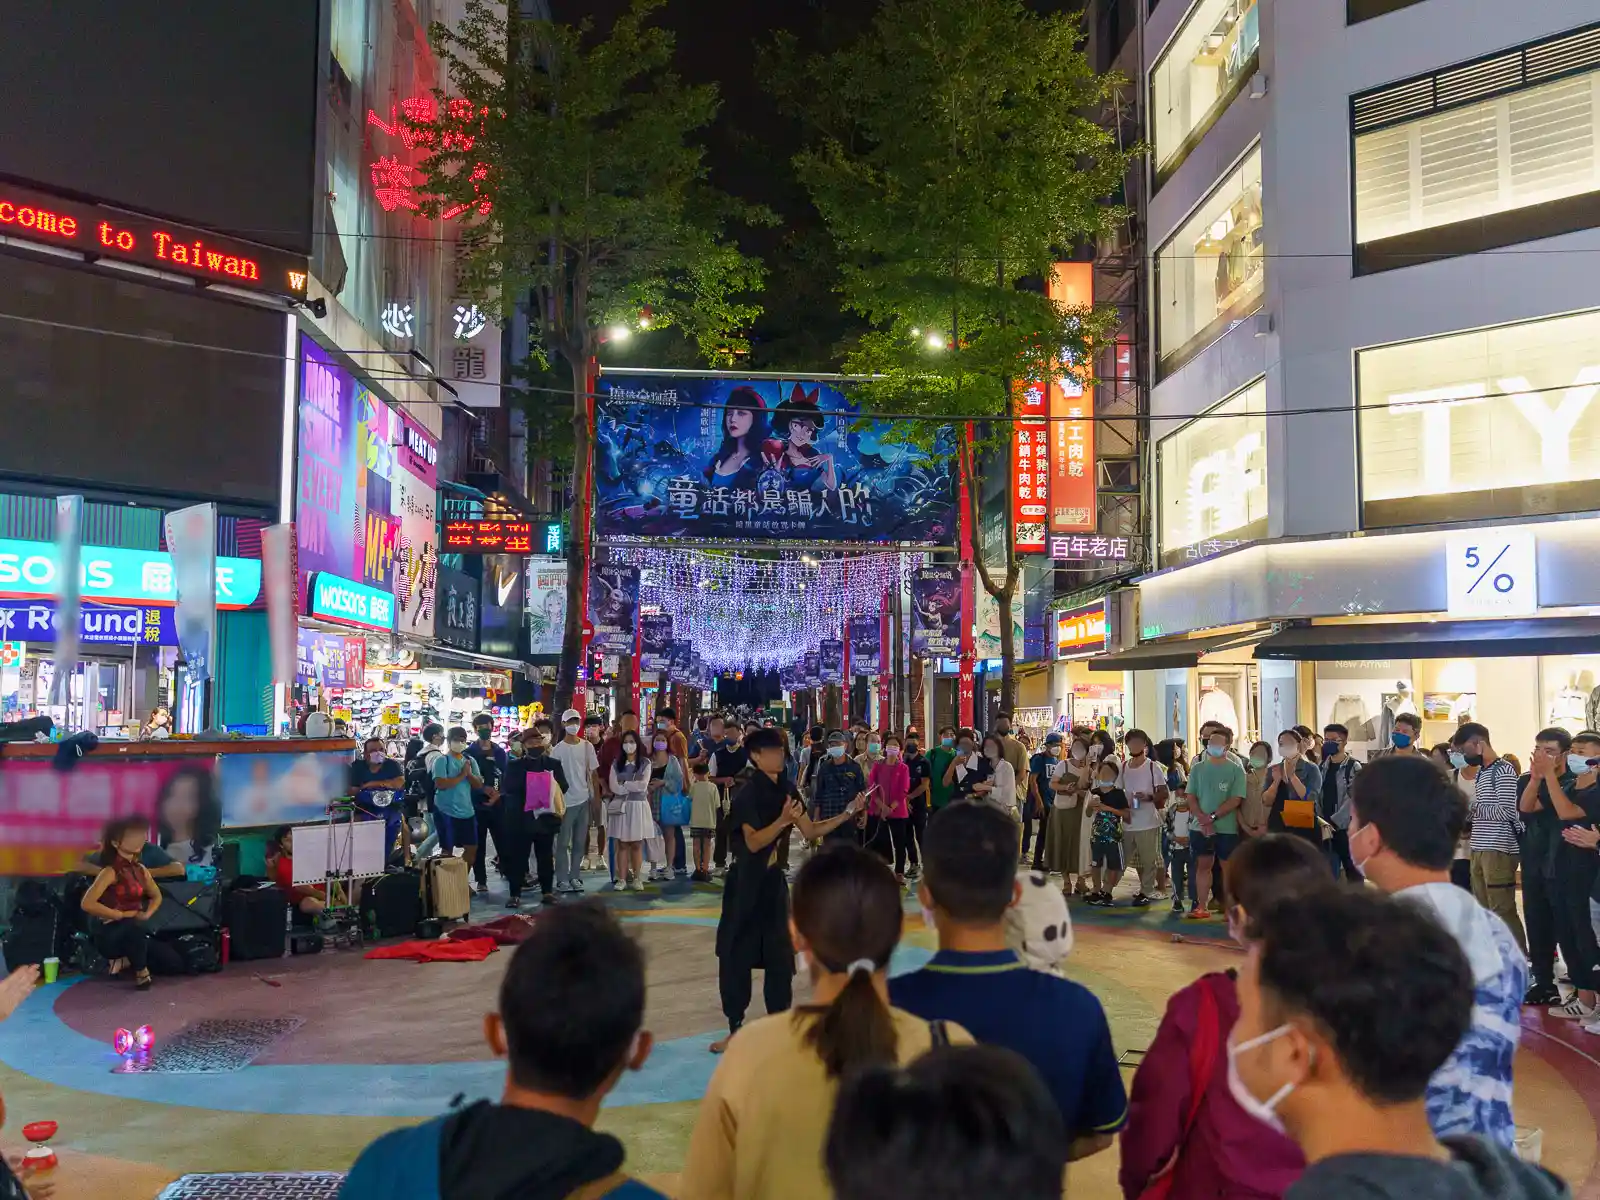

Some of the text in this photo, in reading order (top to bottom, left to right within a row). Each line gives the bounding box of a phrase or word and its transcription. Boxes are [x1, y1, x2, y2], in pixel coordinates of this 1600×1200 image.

[100, 221, 134, 250] to
[153, 232, 258, 280] Taiwan
[305, 354, 341, 423] MORE
[408, 427, 428, 459] MEAT
[1068, 407, 1084, 477] 手工肉乾
[301, 454, 343, 515] EVERY
[667, 476, 873, 527] 童話都是騙人的
[300, 502, 329, 556] DAY
[1050, 536, 1128, 558] 百年老店
[142, 561, 233, 597] 屈氏
[320, 583, 366, 616] watsons
[144, 609, 161, 642] 退稅
[962, 673, 971, 681] W
[1335, 660, 1391, 668] New Arrival
[963, 690, 972, 698] 14
